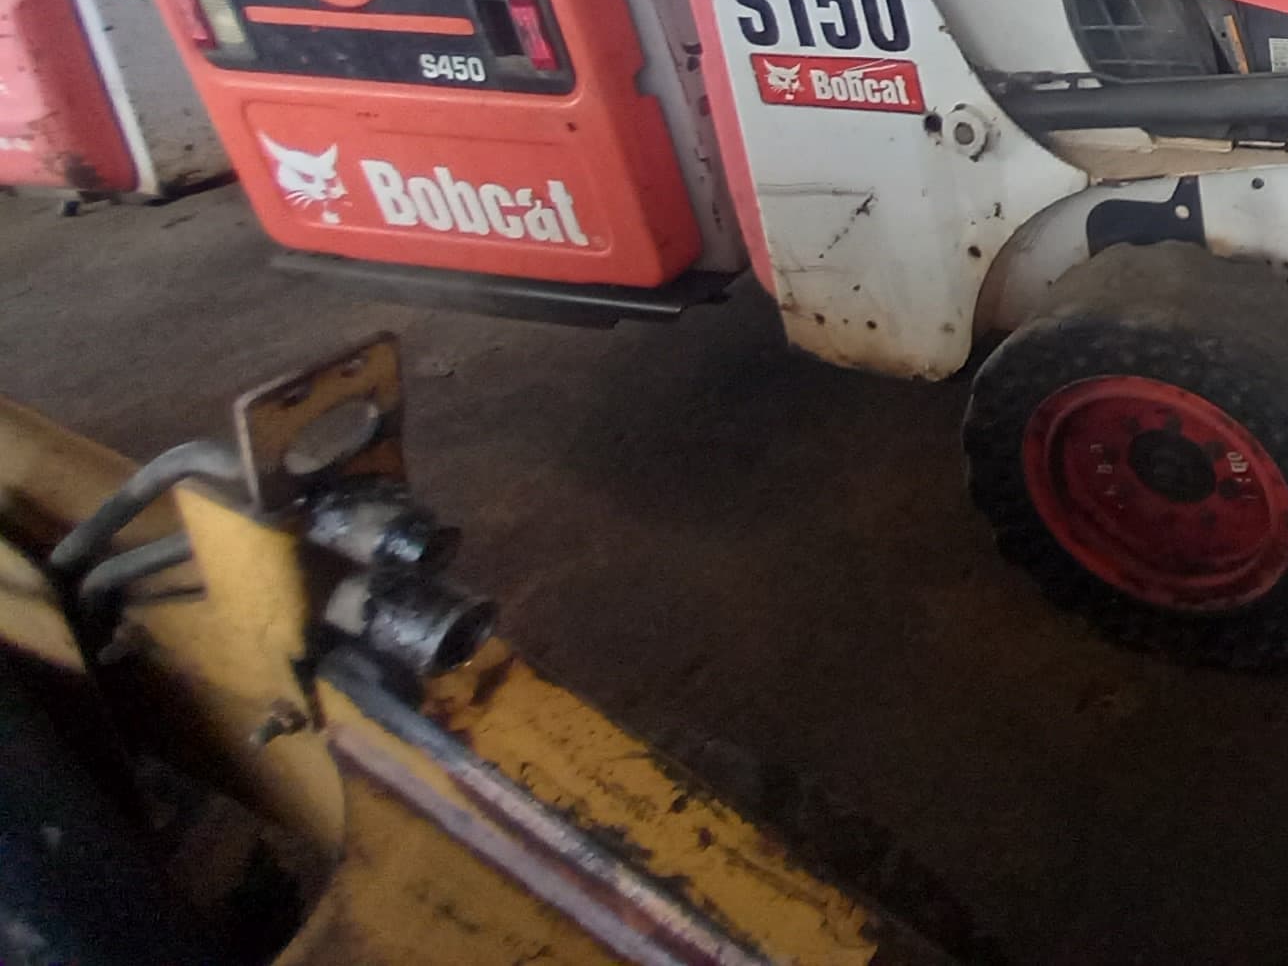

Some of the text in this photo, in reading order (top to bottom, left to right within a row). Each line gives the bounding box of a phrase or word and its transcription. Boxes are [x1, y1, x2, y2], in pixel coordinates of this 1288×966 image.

[419, 53, 486, 82] S450
[809, 68, 911, 105] Bobcat
[360, 159, 589, 247] Bobcat
